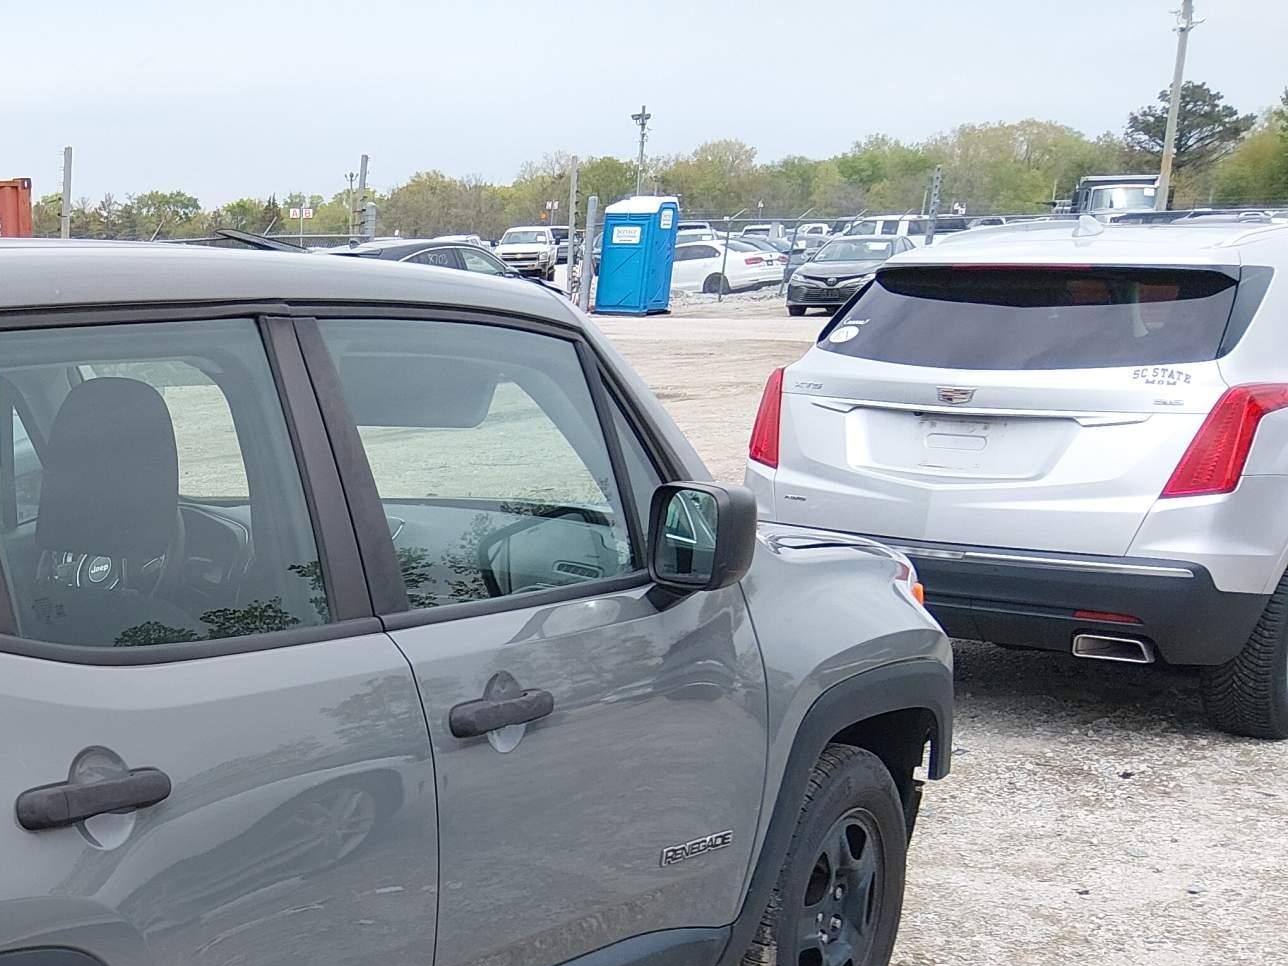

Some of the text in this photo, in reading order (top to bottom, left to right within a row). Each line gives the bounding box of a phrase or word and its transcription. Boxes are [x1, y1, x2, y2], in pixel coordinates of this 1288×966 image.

[1132, 367, 1192, 385] SC STATE
[662, 829, 733, 867] RENEGADE
